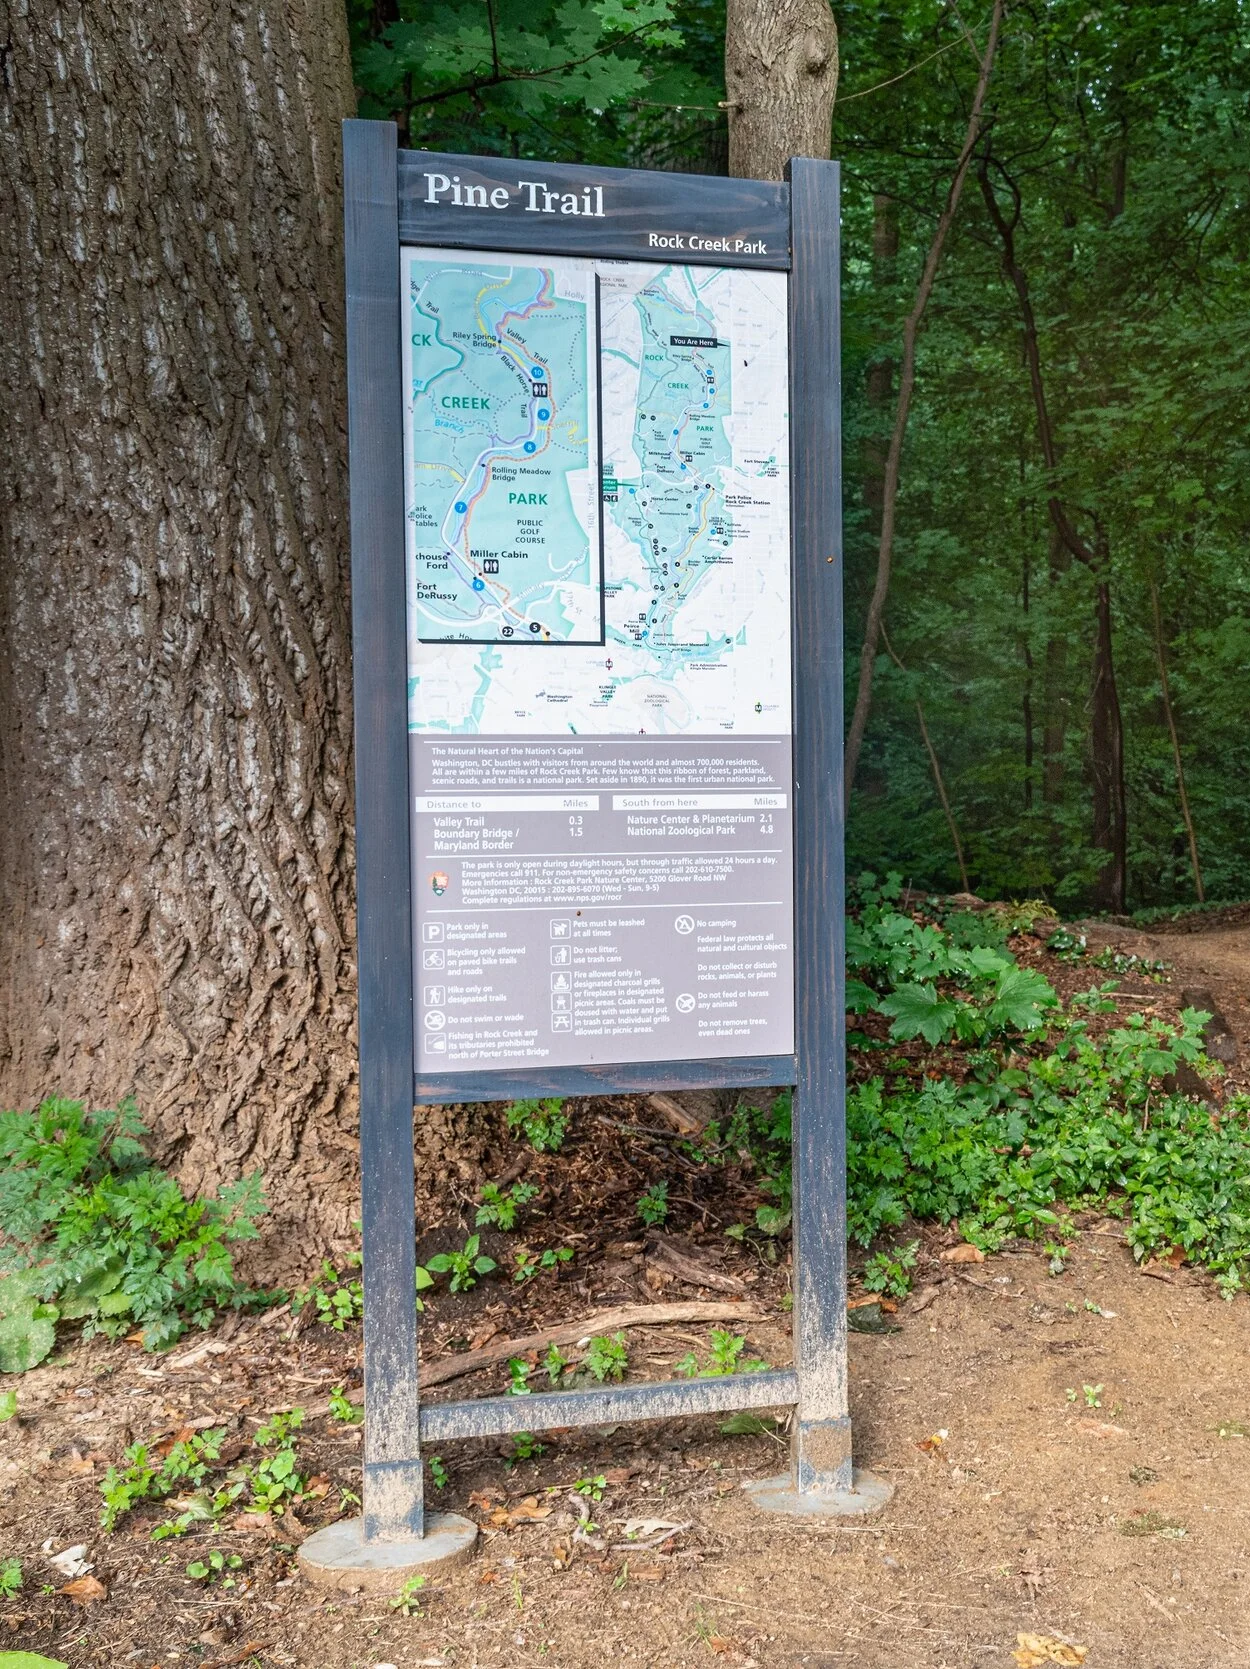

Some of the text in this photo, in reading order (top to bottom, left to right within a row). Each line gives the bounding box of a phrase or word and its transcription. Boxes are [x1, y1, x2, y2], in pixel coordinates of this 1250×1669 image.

[424, 173, 606, 217] Pine Trail
[649, 233, 767, 255] Rock Creek Park
[564, 290, 585, 300] Holly
[426, 301, 440, 314] Trail
[412, 334, 431, 346] CK
[453, 332, 497, 342] Riley Spring
[473, 341, 497, 349] Bridge
[507, 328, 549, 365] Valley Trail
[501, 355, 516, 372] Black
[516, 373, 529, 393] Horse
[441, 396, 490, 410] CREEK
[435, 419, 464, 434] Branch
[492, 467, 517, 475] Rolling
[492, 474, 516, 482] Bridge
[509, 493, 548, 505] PARK
[470, 550, 528, 559] Miller Cabin
[417, 582, 437, 590] Fort
[417, 592, 458, 601] DeRussy
[558, 748, 584, 756] Capital
[432, 760, 480, 768] Washington,
[523, 759, 540, 767] with
[427, 801, 482, 809] Distance to
[622, 799, 698, 807] South from here
[754, 798, 778, 806] Miles
[433, 817, 485, 828] Valley Trail
[569, 816, 583, 825] 0.3
[627, 814, 755, 824] Nature Center & Planetarium
[760, 814, 772, 823] 2.1
[434, 828, 520, 840] Boundary Bridge /
[570, 828, 583, 837] 1.5
[627, 826, 736, 837] National Zoological Park
[760, 825, 774, 834] 4.8
[434, 840, 514, 852] Maryland Border
[477, 862, 495, 871] park
[504, 861, 521, 870] only
[522, 862, 542, 870] open
[543, 861, 568, 869] during
[569, 860, 601, 869] daylight
[640, 859, 670, 868] through
[762, 857, 778, 866] day.
[462, 871, 509, 879] Emergencies
[556, 869, 613, 877] non-emergency
[614, 868, 637, 877] safety
[685, 866, 735, 874] 202-610-7500.
[464, 923, 481, 932] only
[618, 919, 646, 927] leashed
[708, 920, 737, 929] camping
[446, 932, 487, 941] designated
[448, 1016, 459, 1024] Do
[460, 1016, 473, 1024] not
[474, 1015, 494, 1023] swim
[716, 1028, 733, 1036] dead
